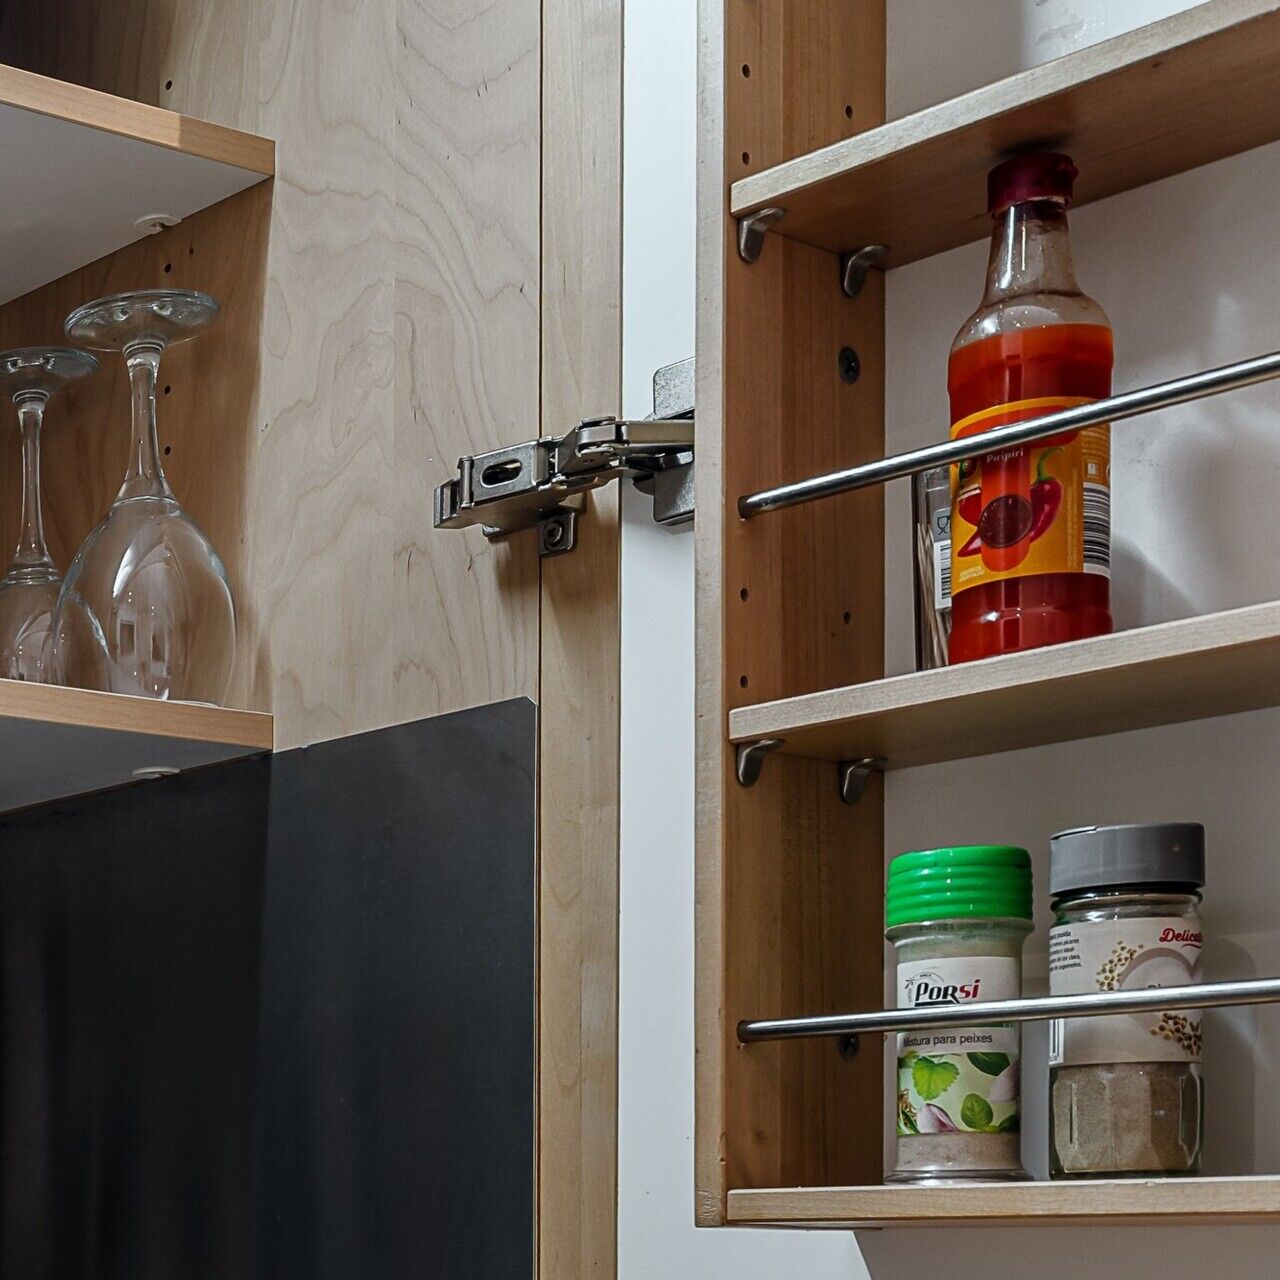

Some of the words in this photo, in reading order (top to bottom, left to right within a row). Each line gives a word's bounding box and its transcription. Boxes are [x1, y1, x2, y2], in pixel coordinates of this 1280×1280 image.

[986, 448, 1024, 463] Piripiri
[933, 1035, 957, 1046] para
[960, 1032, 993, 1045] peixes
